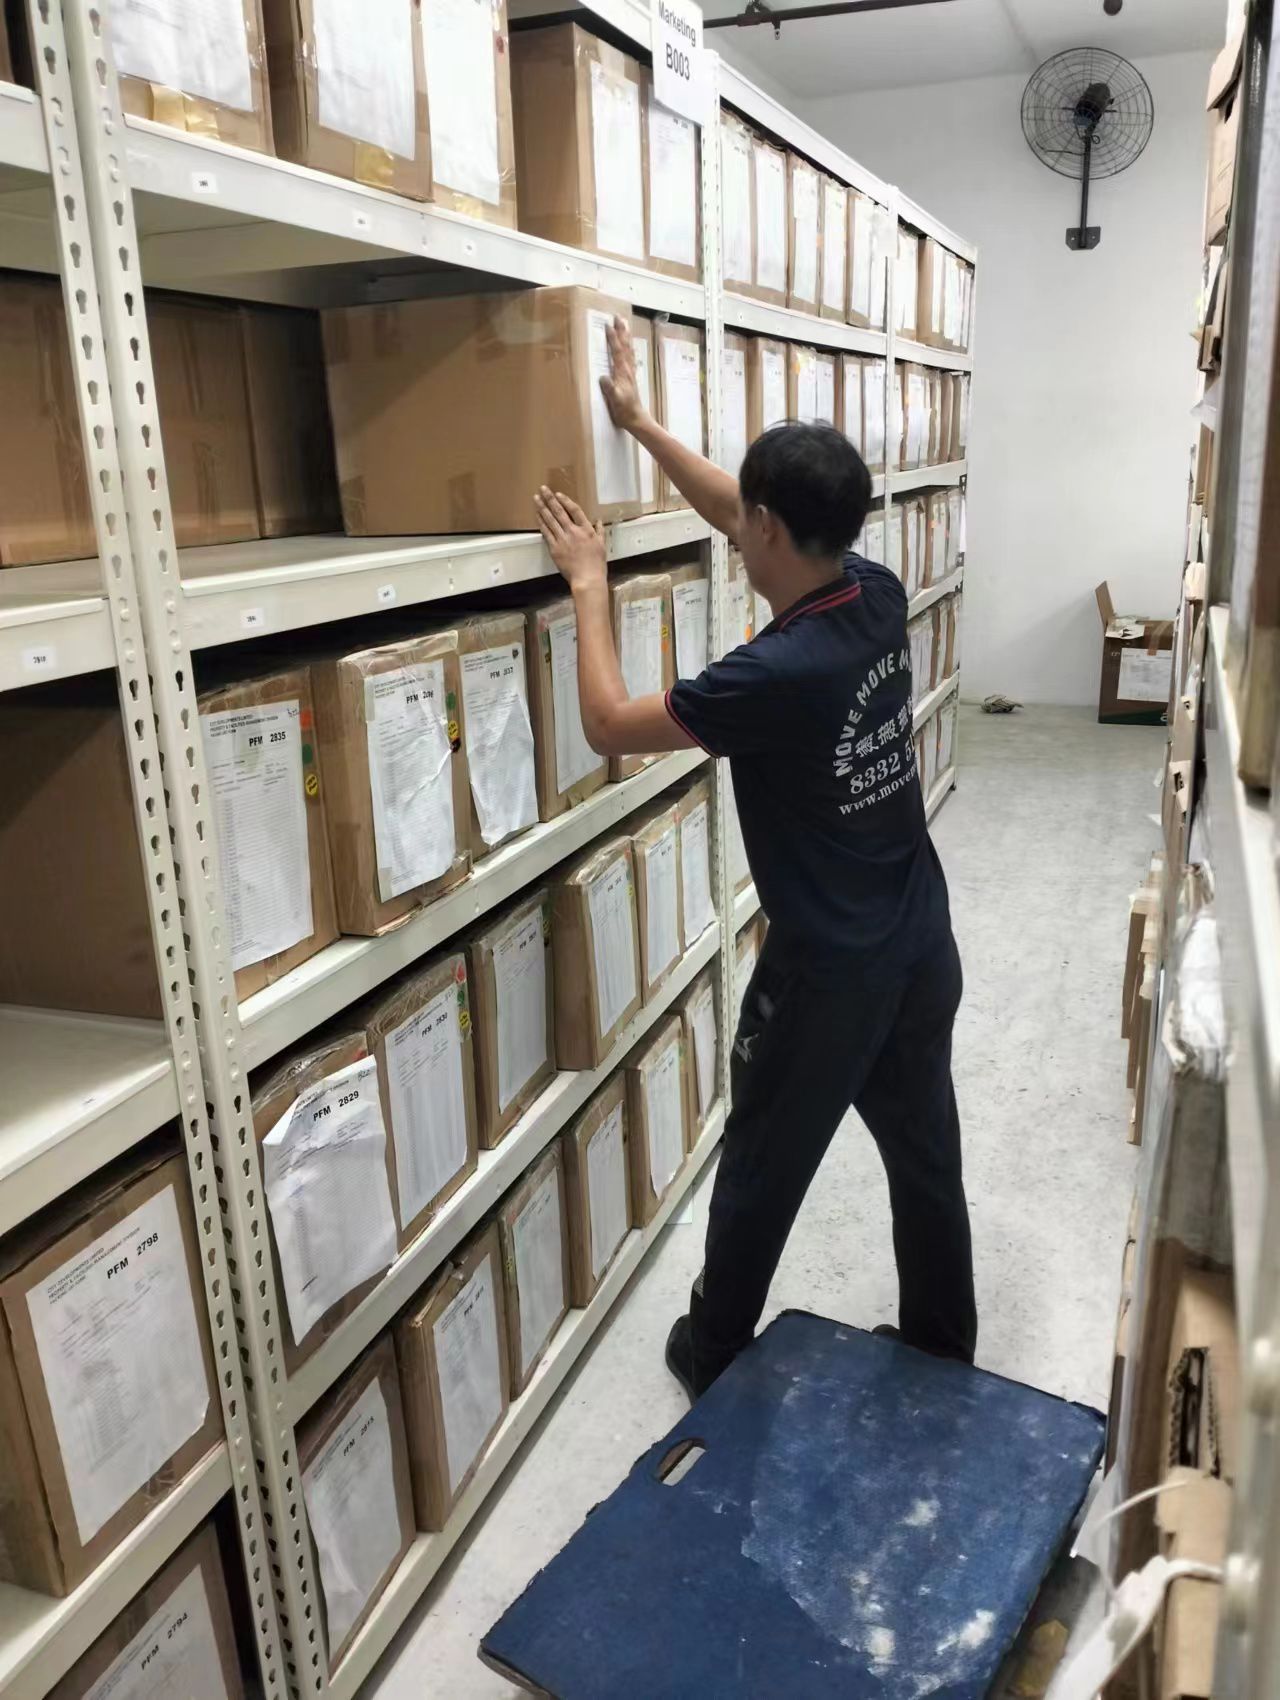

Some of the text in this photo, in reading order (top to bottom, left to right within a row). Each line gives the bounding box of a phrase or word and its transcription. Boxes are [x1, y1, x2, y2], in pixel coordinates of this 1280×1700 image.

[658, 0, 697, 47] Marketing
[665, 42, 690, 81] B003
[406, 693, 419, 704] PFM
[832, 648, 912, 777] MOVE MOVE M
[249, 736, 263, 747] PFM
[838, 762, 917, 816] www.move
[850, 751, 901, 794] 8332
[421, 1023, 433, 1038] PFM
[312, 1105, 332, 1122] PFM
[338, 1090, 360, 1108] 2829
[107, 1232, 159, 1279] PFM 2798
[343, 1438, 356, 1457] PFM
[141, 1644, 160, 1671] PFM
